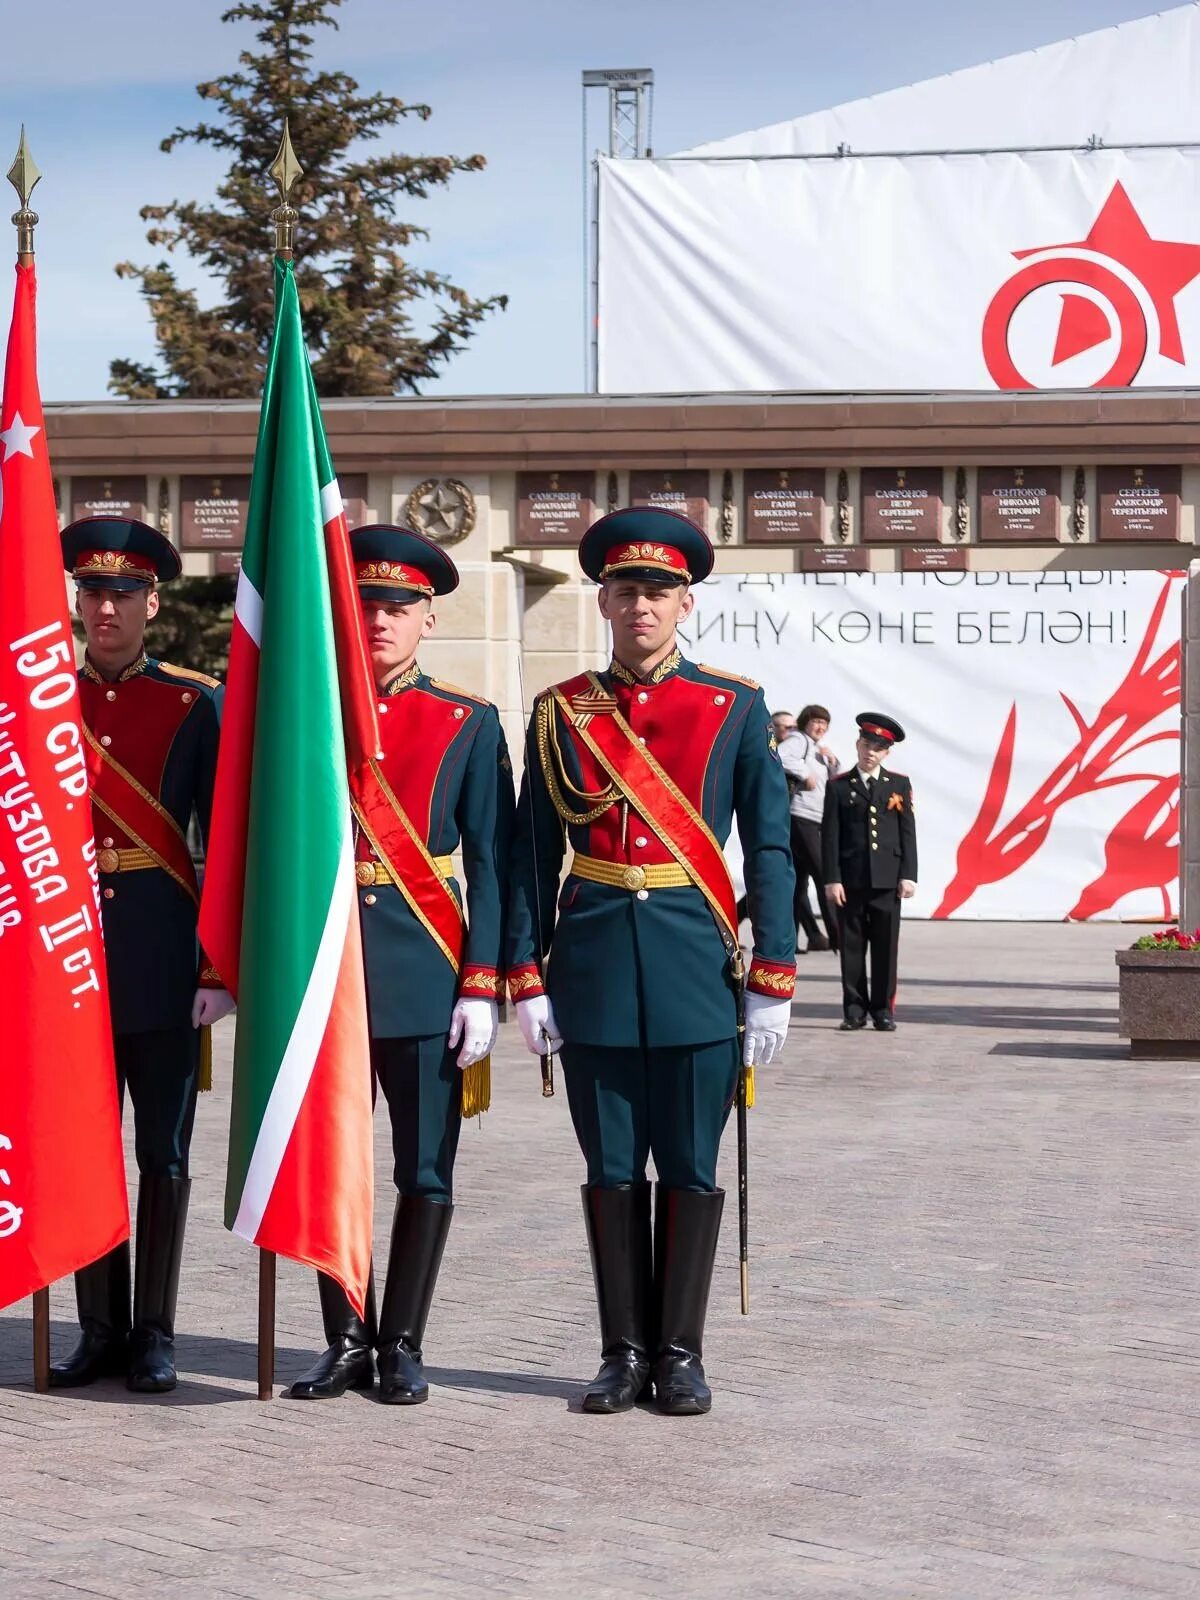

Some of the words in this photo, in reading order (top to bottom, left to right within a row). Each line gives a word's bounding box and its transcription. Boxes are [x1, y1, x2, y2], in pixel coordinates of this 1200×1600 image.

[875, 489, 929, 499] САФРОНОВ
[992, 488, 1048, 497] СЕНТЮКОВ
[1118, 488, 1160, 497] СЕРГЕЕВ
[999, 496, 1040, 506] НИКОЛАЙ
[1114, 498, 1164, 507] АЛЕКСАНДР
[998, 507, 1041, 516] ПЕТРОВИЧ
[1110, 507, 1169, 516] ТЕРЕНТЬЕВИЧ
[676, 610, 790, 648] ИҢҮ
[812, 610, 935, 644] КӨНЕ
[957, 610, 1127, 644] БЕЛӘН!
[9, 621, 77, 711] 150
